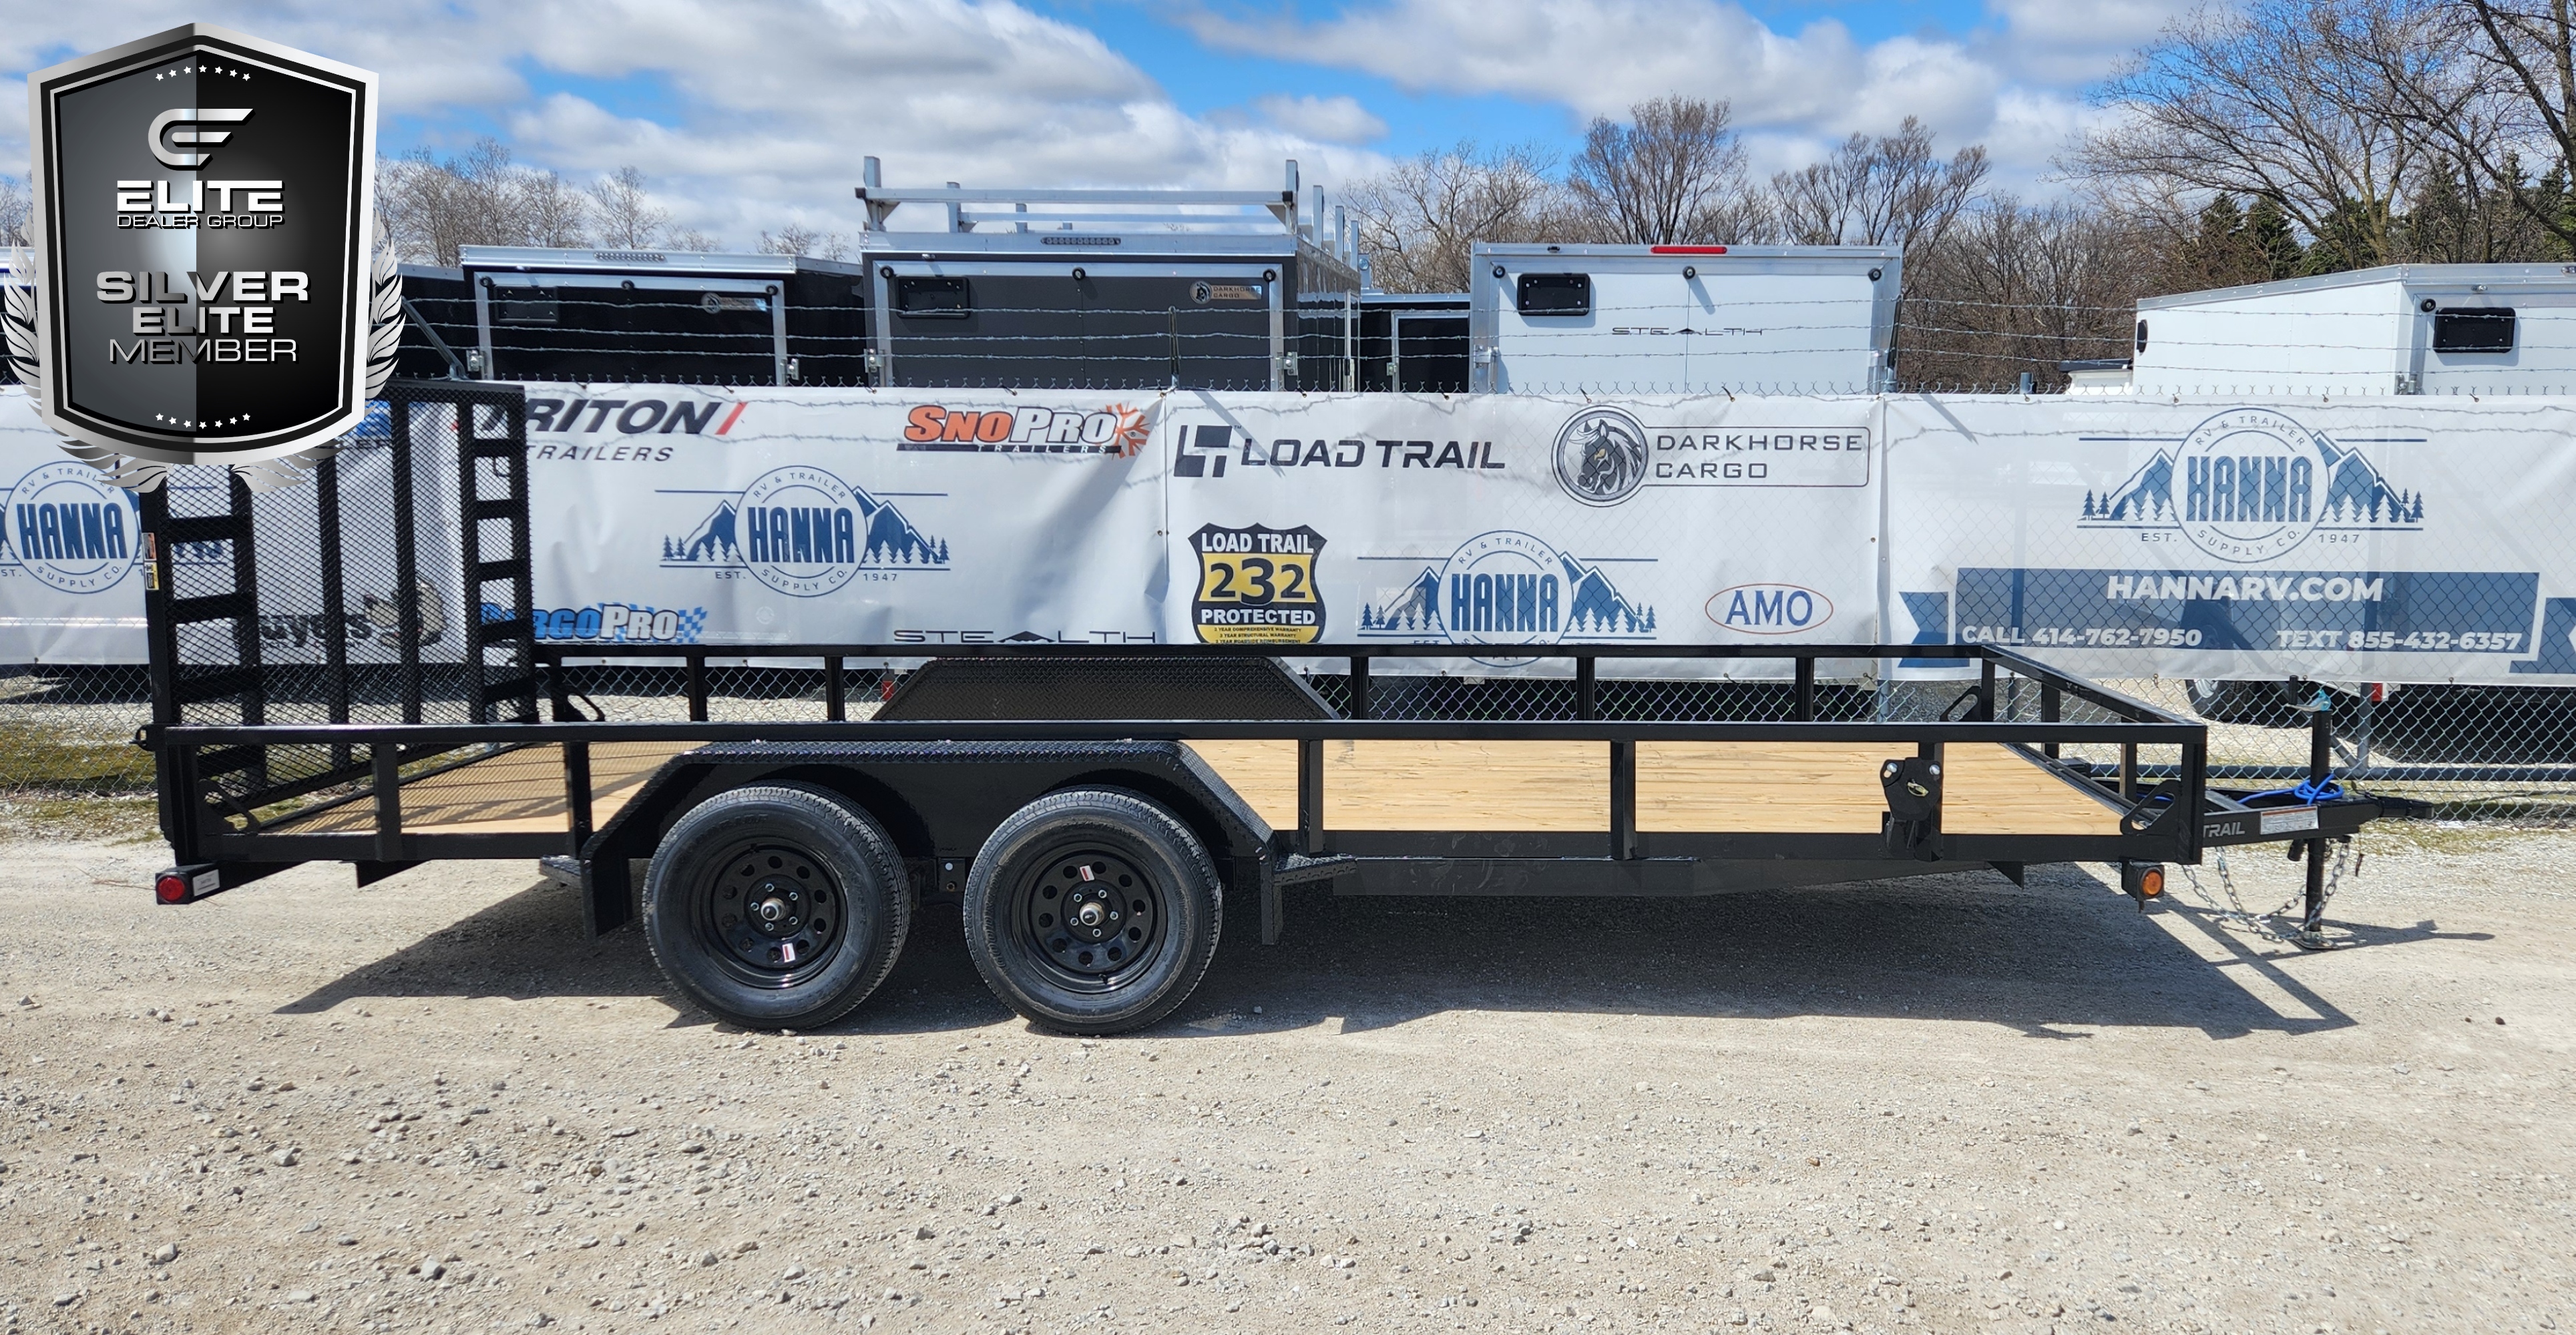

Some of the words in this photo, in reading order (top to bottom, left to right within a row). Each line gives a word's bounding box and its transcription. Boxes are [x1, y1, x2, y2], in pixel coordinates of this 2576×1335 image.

[1612, 327, 1763, 336] STEALTH
[2195, 429, 2213, 446] RV
[2221, 420, 2229, 429] &
[2239, 416, 2305, 446] TRAILER
[977, 445, 1106, 453] TRAILERS
[1241, 438, 1365, 467] LOAD
[1375, 440, 1505, 469] TRAIL
[1656, 435, 1863, 451] DARKHORSE
[1655, 463, 1768, 479] CARGO
[22, 479, 36, 494] RV
[753, 483, 767, 498] RV
[789, 472, 846, 499] TRAILER
[2186, 455, 2312, 521] HANNA
[17, 503, 128, 559] HANNA
[747, 507, 855, 563] HANNA
[2141, 533, 2177, 542] EST.
[2318, 534, 2360, 543] 1947
[1202, 533, 1253, 552] LOAD
[1257, 533, 1314, 553] TRAIL
[1458, 549, 1472, 564] RV
[1496, 538, 1552, 565] TRAILER
[2197, 529, 2264, 555] SUPPLY
[2276, 530, 2300, 547] CO.
[0, 569, 22, 577] ST.
[37, 566, 95, 587] SUPPLY
[104, 565, 122, 579] CO.
[715, 571, 746, 579] EST.
[761, 569, 819, 591] SUPPLY
[829, 569, 847, 584] CO.
[863, 573, 897, 581] 1947
[1211, 557, 1306, 605] 232
[2107, 575, 2384, 601] HANNARV.COM
[1452, 573, 1558, 631] HANNA
[1724, 590, 1813, 625] AMO
[1201, 609, 1315, 625] PROTECTED
[894, 629, 1156, 643] STEALTH
[1962, 625, 2025, 644] CALL
[2032, 627, 2203, 646] 414-762-7950
[2276, 630, 2342, 647] TEXT
[2347, 631, 2523, 650] 855-432-6357
